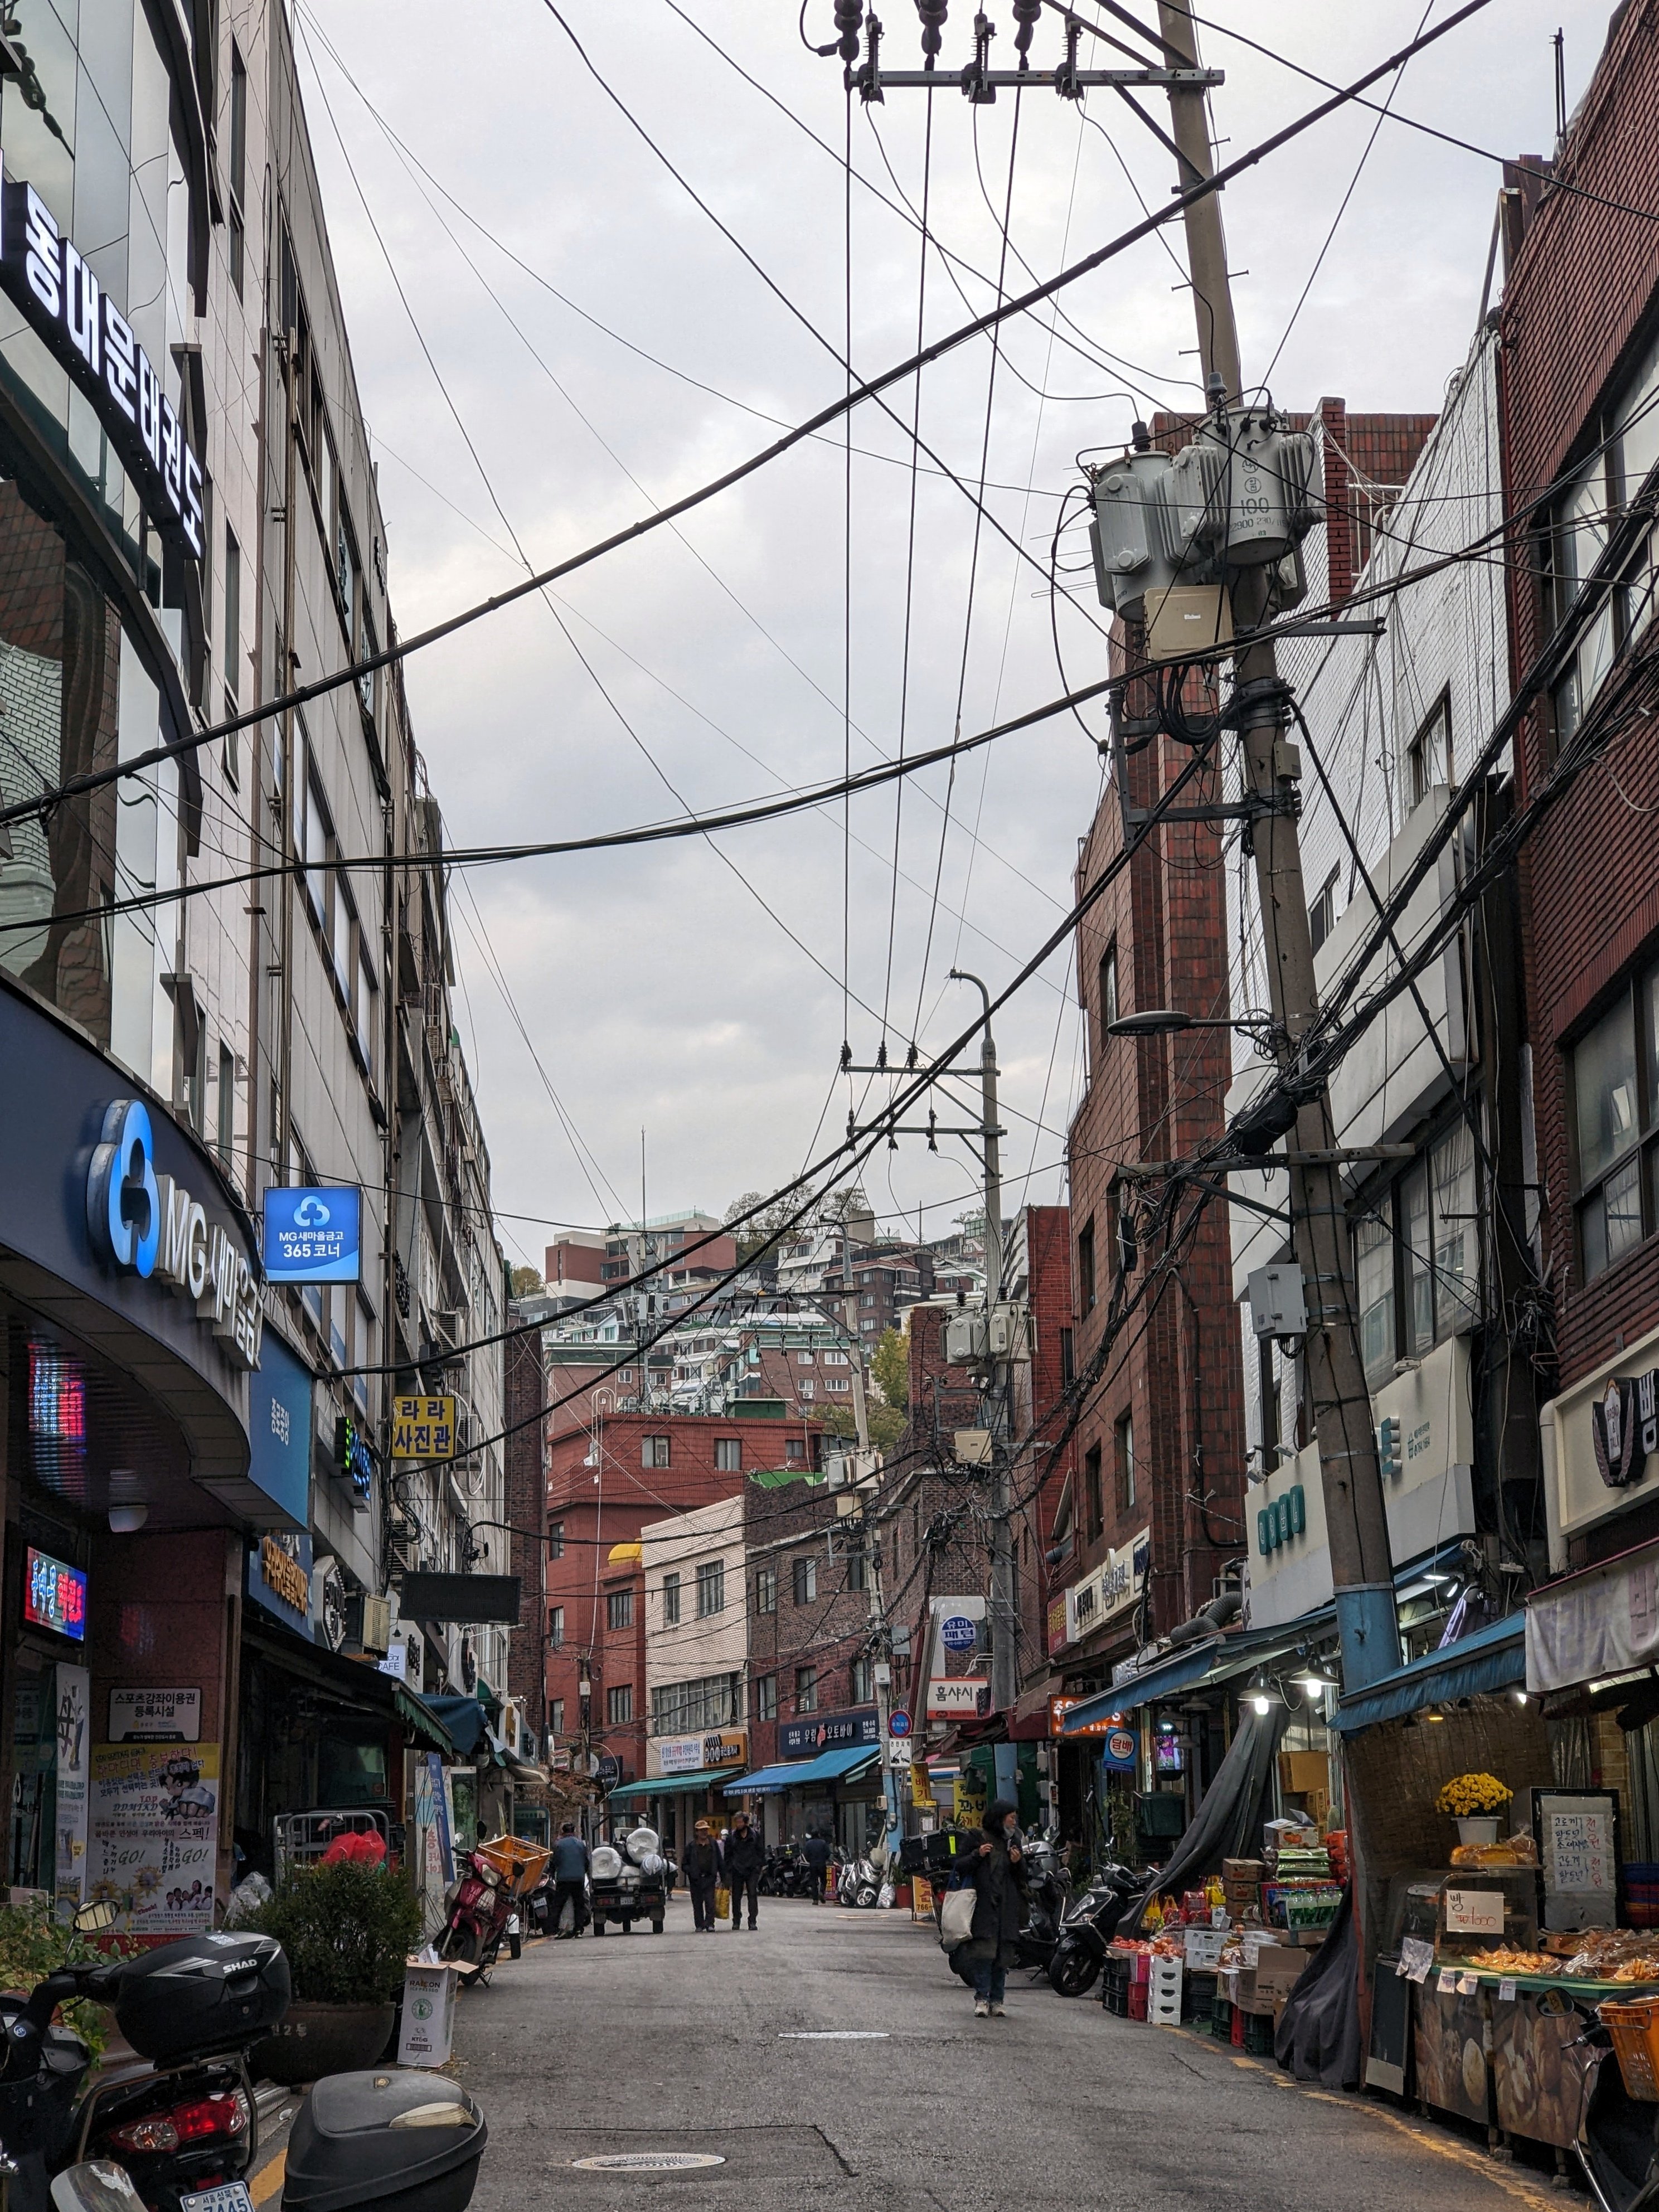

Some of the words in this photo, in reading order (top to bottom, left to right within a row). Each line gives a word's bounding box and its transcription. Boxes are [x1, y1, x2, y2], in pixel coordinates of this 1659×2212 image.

[26, 182, 202, 559] 동대문태권도
[1241, 497, 1269, 516] 100
[283, 1244, 311, 1258] 365
[313, 1243, 340, 1258] 코너
[271, 1397, 290, 1447] 종로중앙
[394, 1424, 450, 1454] 사진관
[947, 1620, 968, 1629] 유미
[944, 1629, 974, 1639] 패턴
[377, 1662, 400, 1671] CAFE
[115, 1692, 196, 1705] 스포츠강좌이용권
[935, 1685, 973, 1702] 홈샤시
[134, 1705, 175, 1718] 등록시설
[827, 1722, 853, 1739] 오토바이
[1112, 1738, 1133, 1752] 담배
[98, 1757, 141, 1778] 한마디면
[178, 1827, 210, 1841] 스펙!
[119, 1849, 146, 1866] GO!
[182, 1848, 209, 1865] GO!
[1449, 1892, 1464, 1912] 빵
[222, 1959, 258, 1974] SHAD
[202, 2195, 216, 2204] 서울
[217, 2189, 232, 2201] 성북
